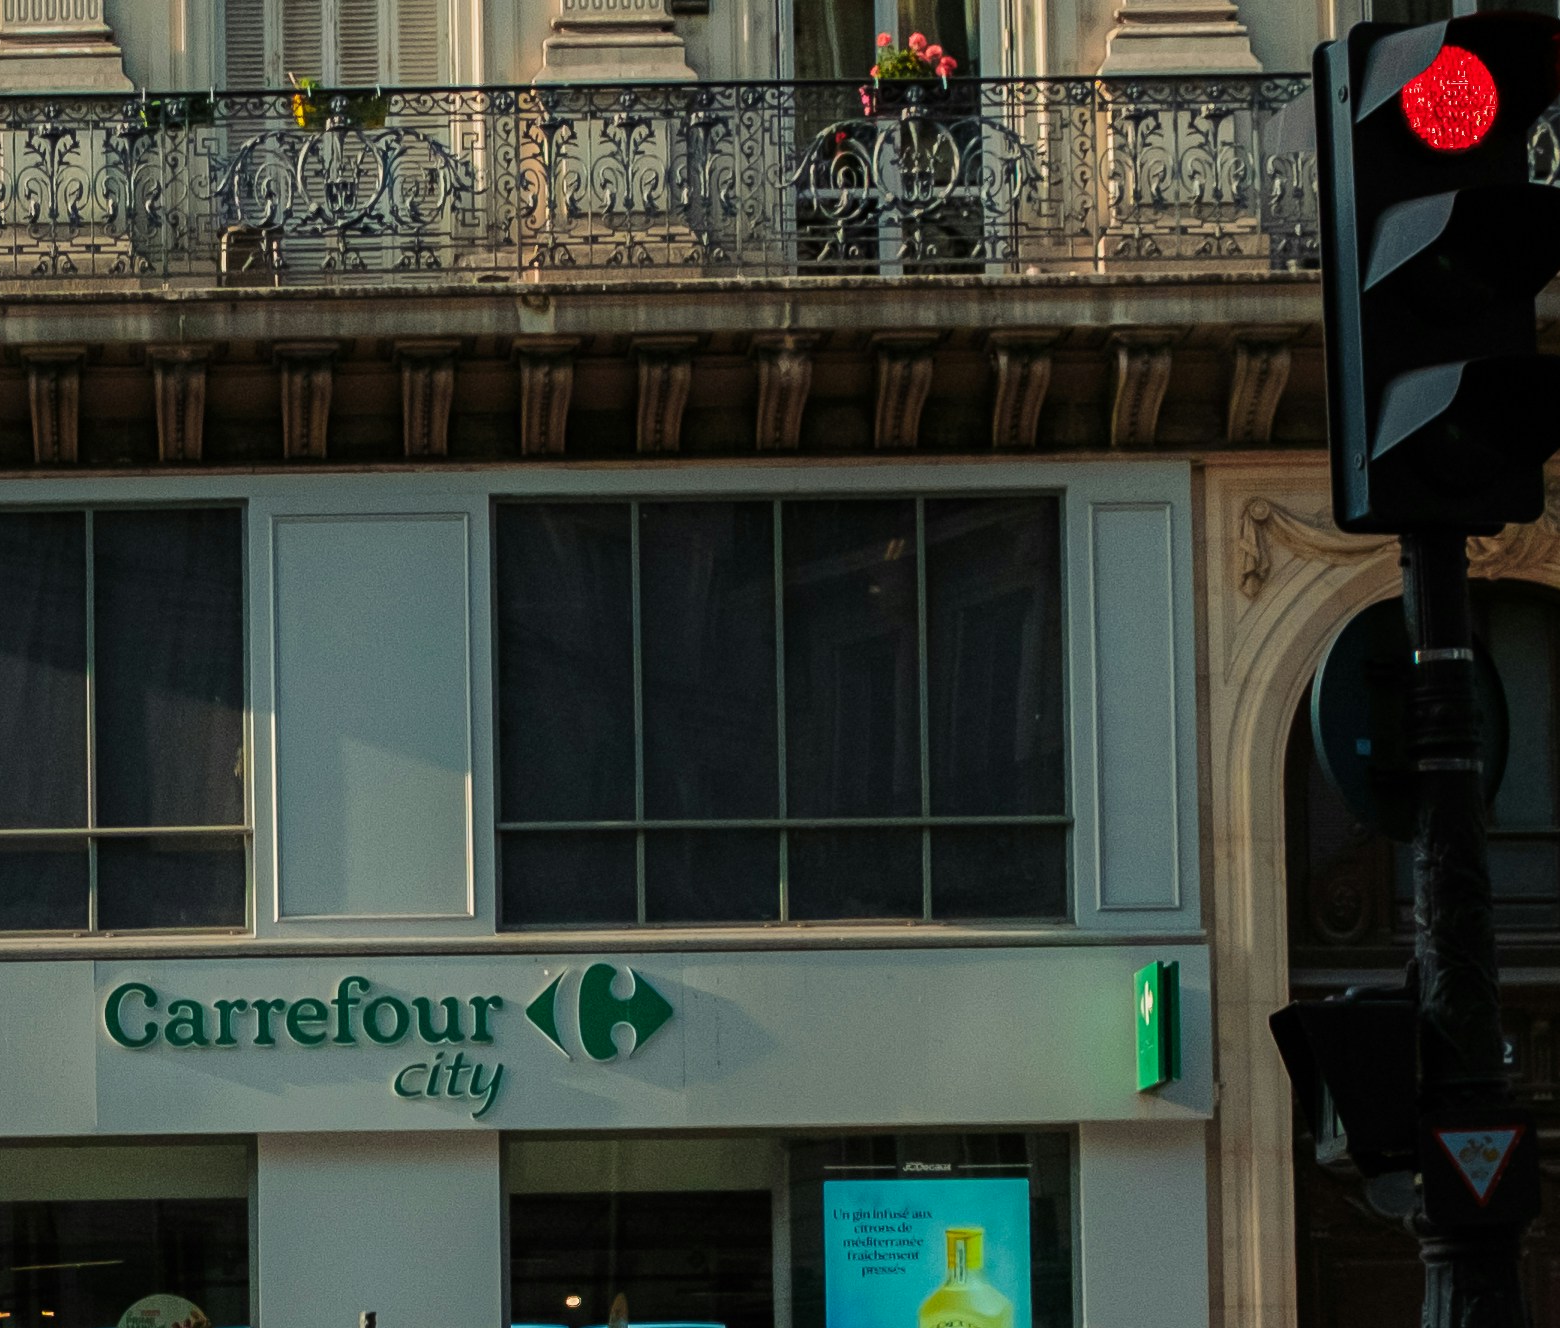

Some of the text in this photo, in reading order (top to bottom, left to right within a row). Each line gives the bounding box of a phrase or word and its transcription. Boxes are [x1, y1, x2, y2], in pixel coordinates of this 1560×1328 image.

[104, 975, 503, 1048] Carrefour
[392, 1052, 504, 1118] city
[833, 1208, 850, 1220] Un
[852, 1209, 870, 1223] gin
[911, 1210, 933, 1219] aux
[854, 1221, 912, 1233] citrons de
